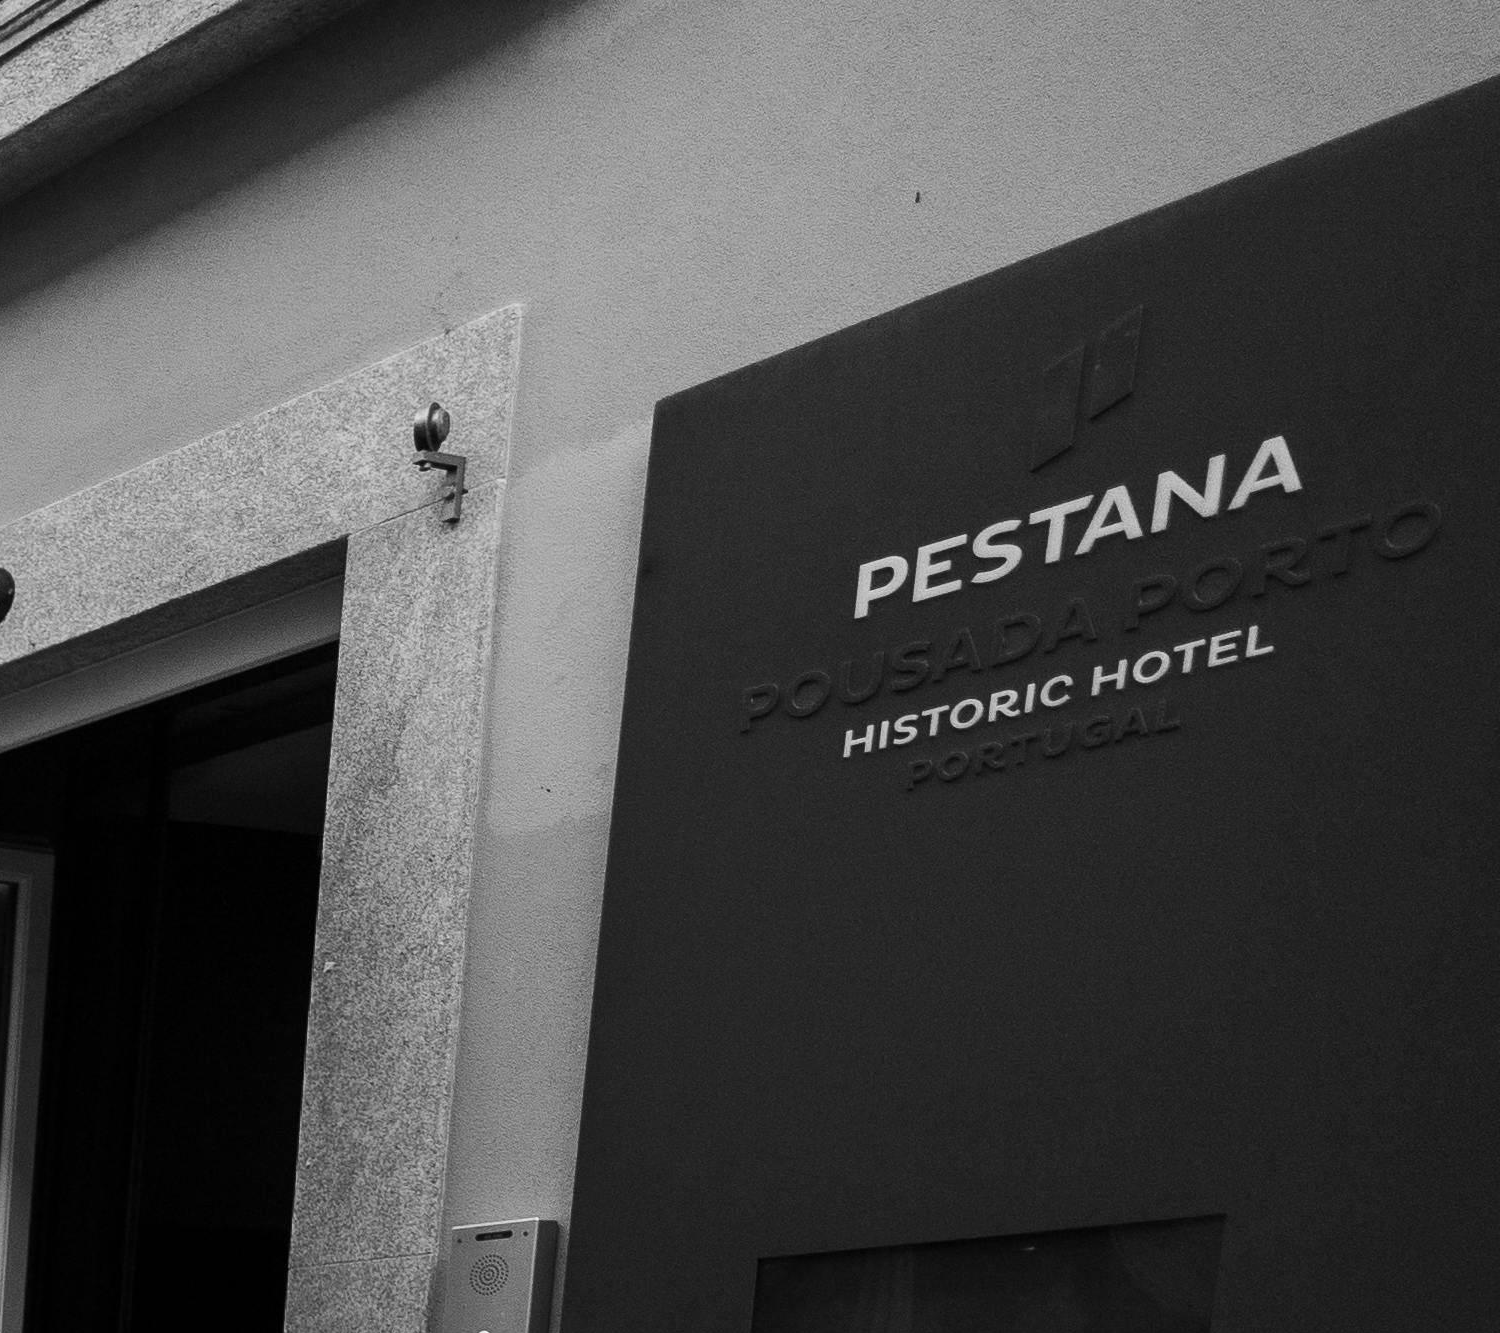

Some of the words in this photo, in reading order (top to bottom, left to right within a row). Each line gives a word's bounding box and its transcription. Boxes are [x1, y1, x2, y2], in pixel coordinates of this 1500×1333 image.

[853, 435, 1303, 619] PESTANA
[738, 599, 1099, 734] POUSADA
[1125, 501, 1444, 630] PORTO
[842, 673, 1075, 758] HISTORIC
[1090, 625, 1274, 699] HOTEL
[905, 698, 1183, 791] PORTUGAL
